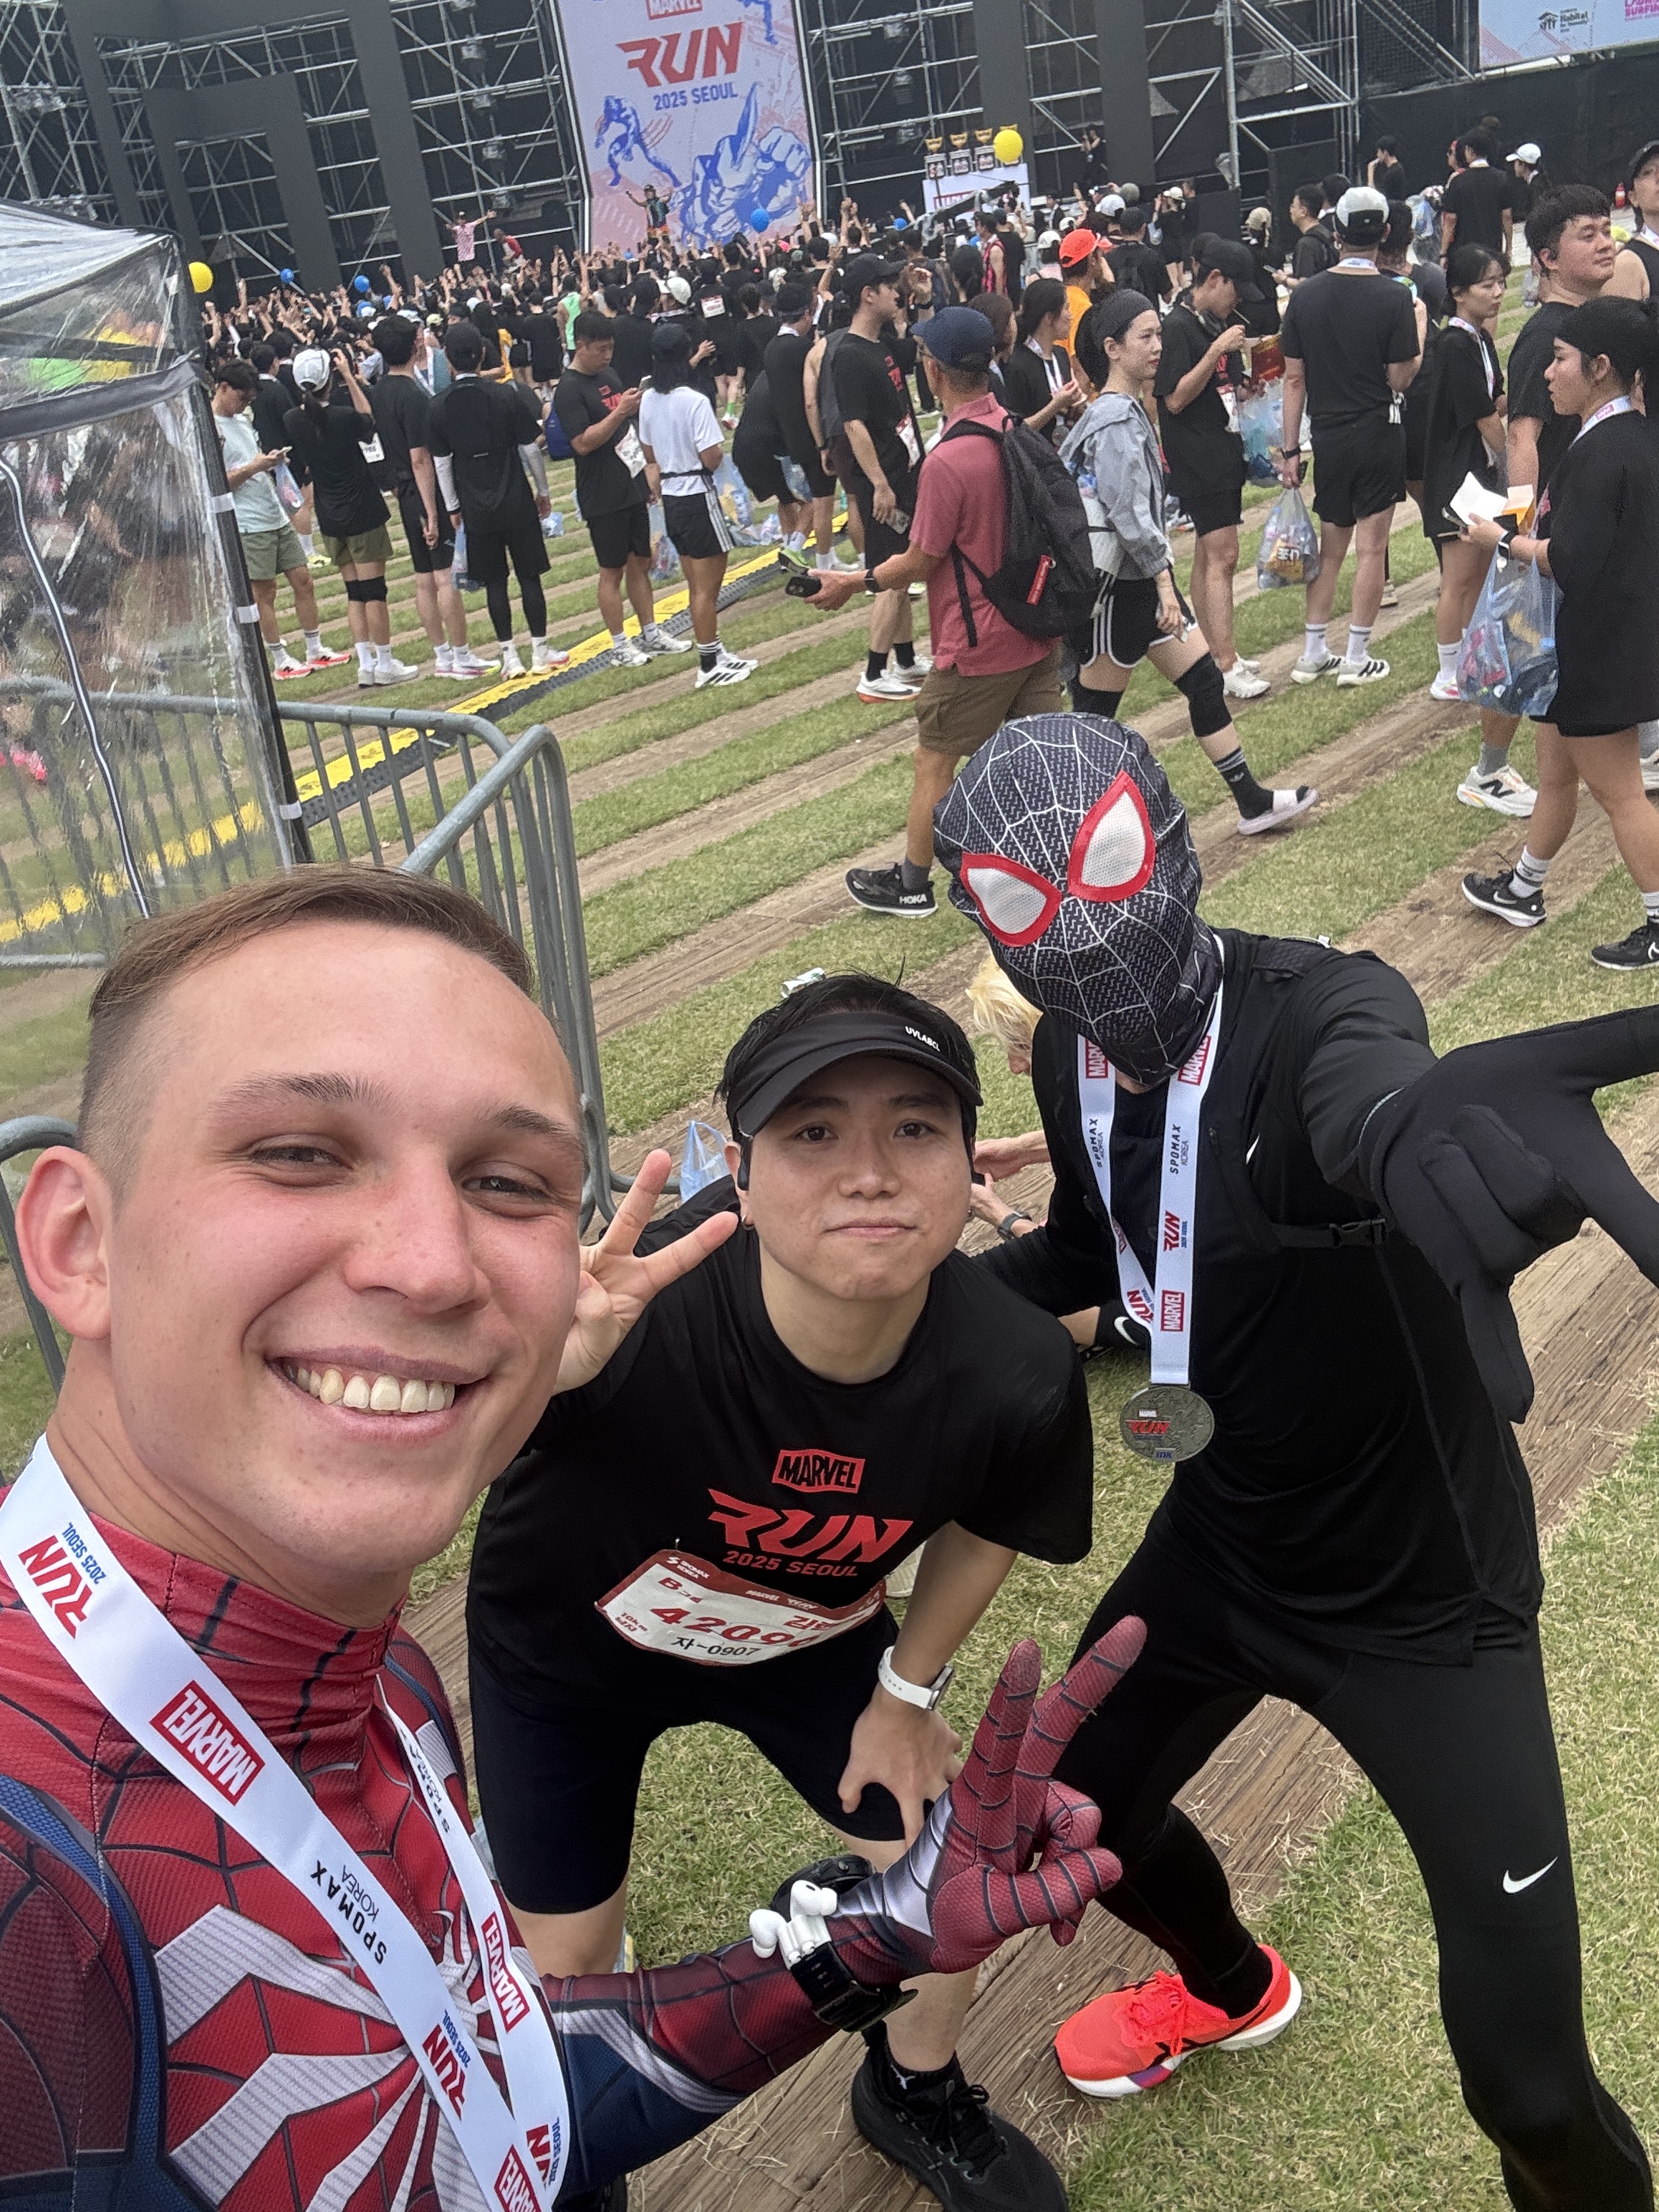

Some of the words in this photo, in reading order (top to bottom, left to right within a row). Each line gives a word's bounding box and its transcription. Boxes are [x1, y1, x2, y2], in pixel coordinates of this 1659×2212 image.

[615, 21, 744, 87] RUN
[653, 90, 688, 111] 2025
[691, 82, 739, 105] SEOUL
[898, 893, 928, 905] HOKA
[1088, 1041, 1106, 1077] MAR
[1090, 1118, 1103, 1168] SPOMAX
[1170, 1124, 1181, 1174] SPOMAX
[1163, 1209, 1180, 1252] RUN
[1163, 1292, 1182, 1330] MARVEL
[778, 1454, 857, 1489] MARVEL
[62, 1521, 88, 1559] SEOUL
[708, 1488, 913, 1562] RUN
[81, 1554, 107, 1585] 2025
[723, 1550, 779, 1571] 2025
[785, 1561, 858, 1577] SEOUL
[18, 1534, 93, 1640] RUN
[620, 1612, 648, 1632] 10km
[670, 1637, 761, 1657] 자-0907
[165, 1688, 258, 1797] MARVEL
[310, 1860, 387, 1965] SPOMAX
[342, 1864, 380, 1923] KOREA
[485, 1916, 526, 2026] MARVEL
[442, 2009, 458, 2046] SEOUL
[422, 2023, 466, 2121] RUN
[455, 2041, 471, 2068] 2025
[552, 2117, 562, 2158] SEOUL
[499, 2151, 537, 2212] RVEL
